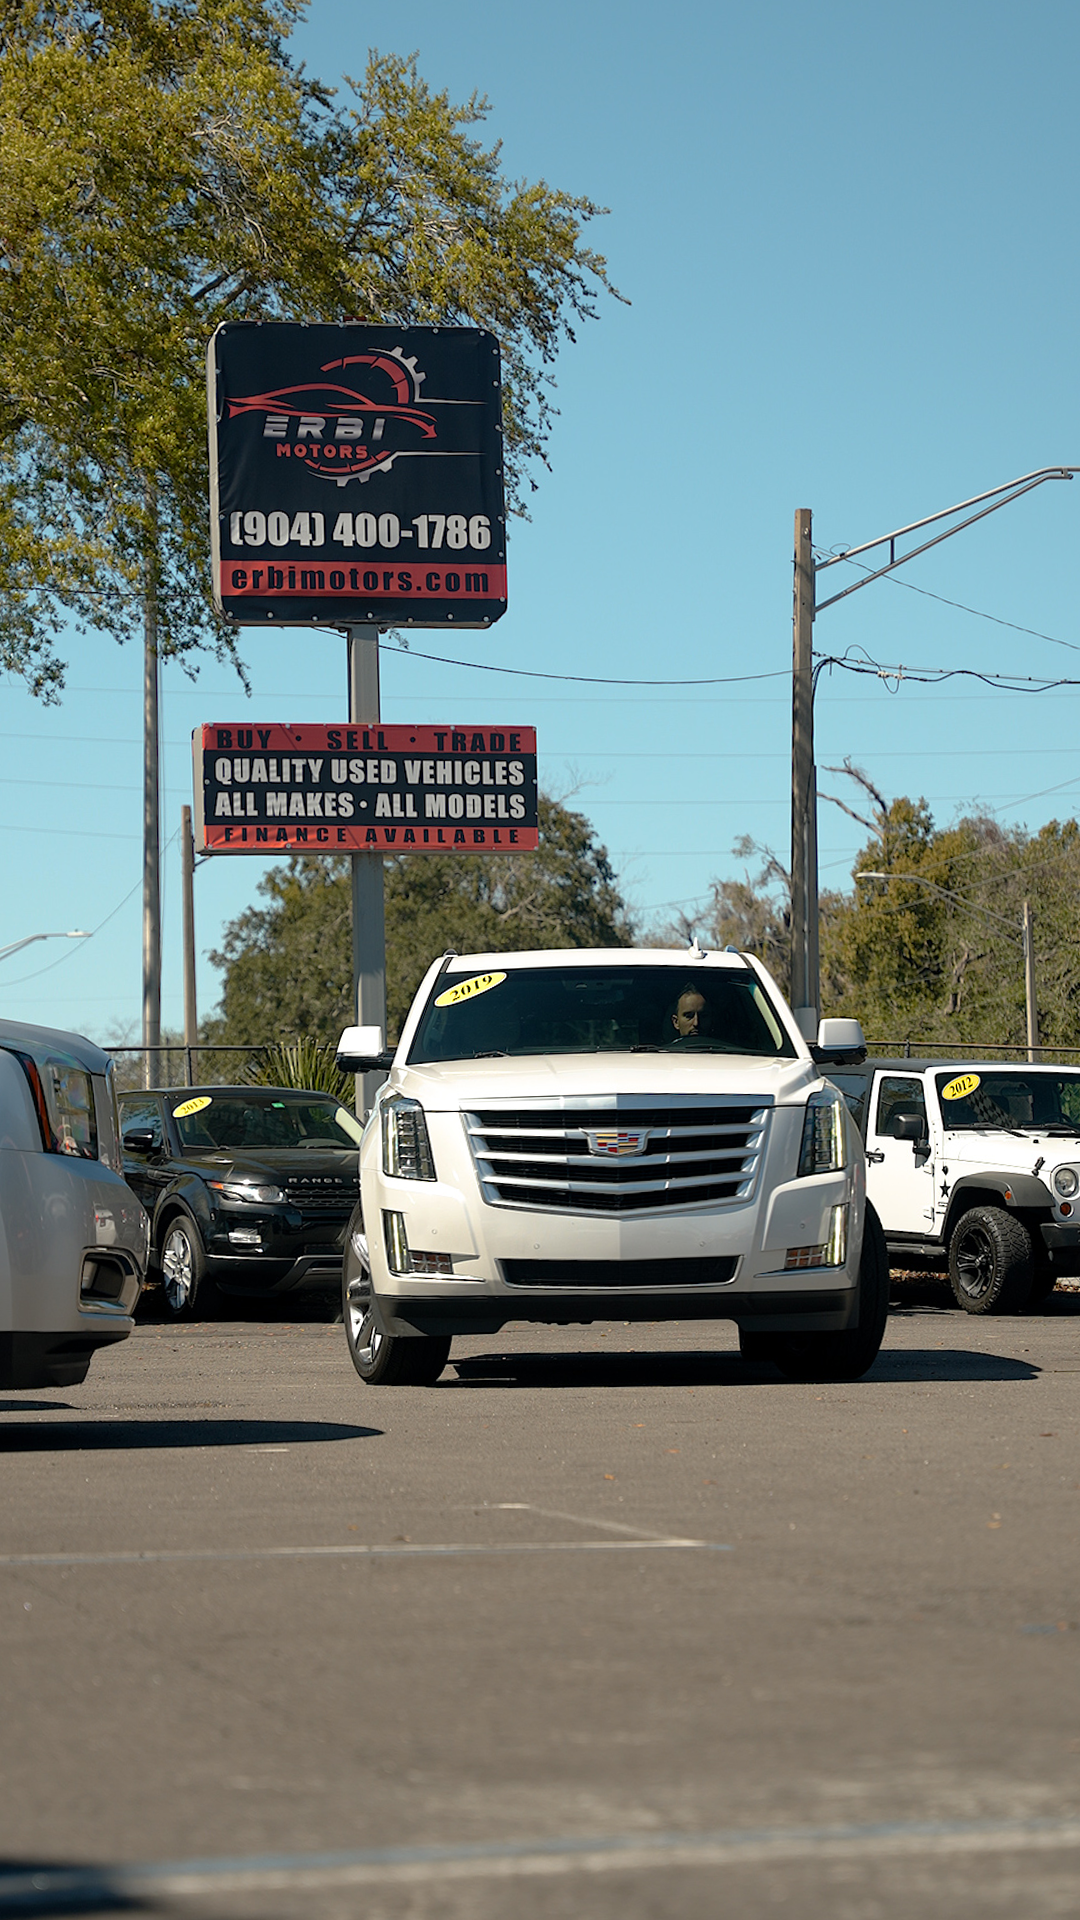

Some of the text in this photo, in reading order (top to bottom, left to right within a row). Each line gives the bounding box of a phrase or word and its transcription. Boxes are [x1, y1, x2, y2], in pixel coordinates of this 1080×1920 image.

[263, 415, 386, 441] ERBI
[276, 443, 368, 460] MOTORS
[230, 511, 492, 550] (904) 400-1786
[231, 565, 489, 593] erbimotors.com
[217, 729, 522, 752] BUY SELL TRADE
[214, 757, 525, 786] QUALITY USED VEHICLES
[214, 792, 526, 819] ALL MAKES ALL MODELS
[224, 827, 520, 844] FINANCE AVAILABLE
[449, 975, 493, 1002] 2019
[949, 1076, 973, 1097] 2012
